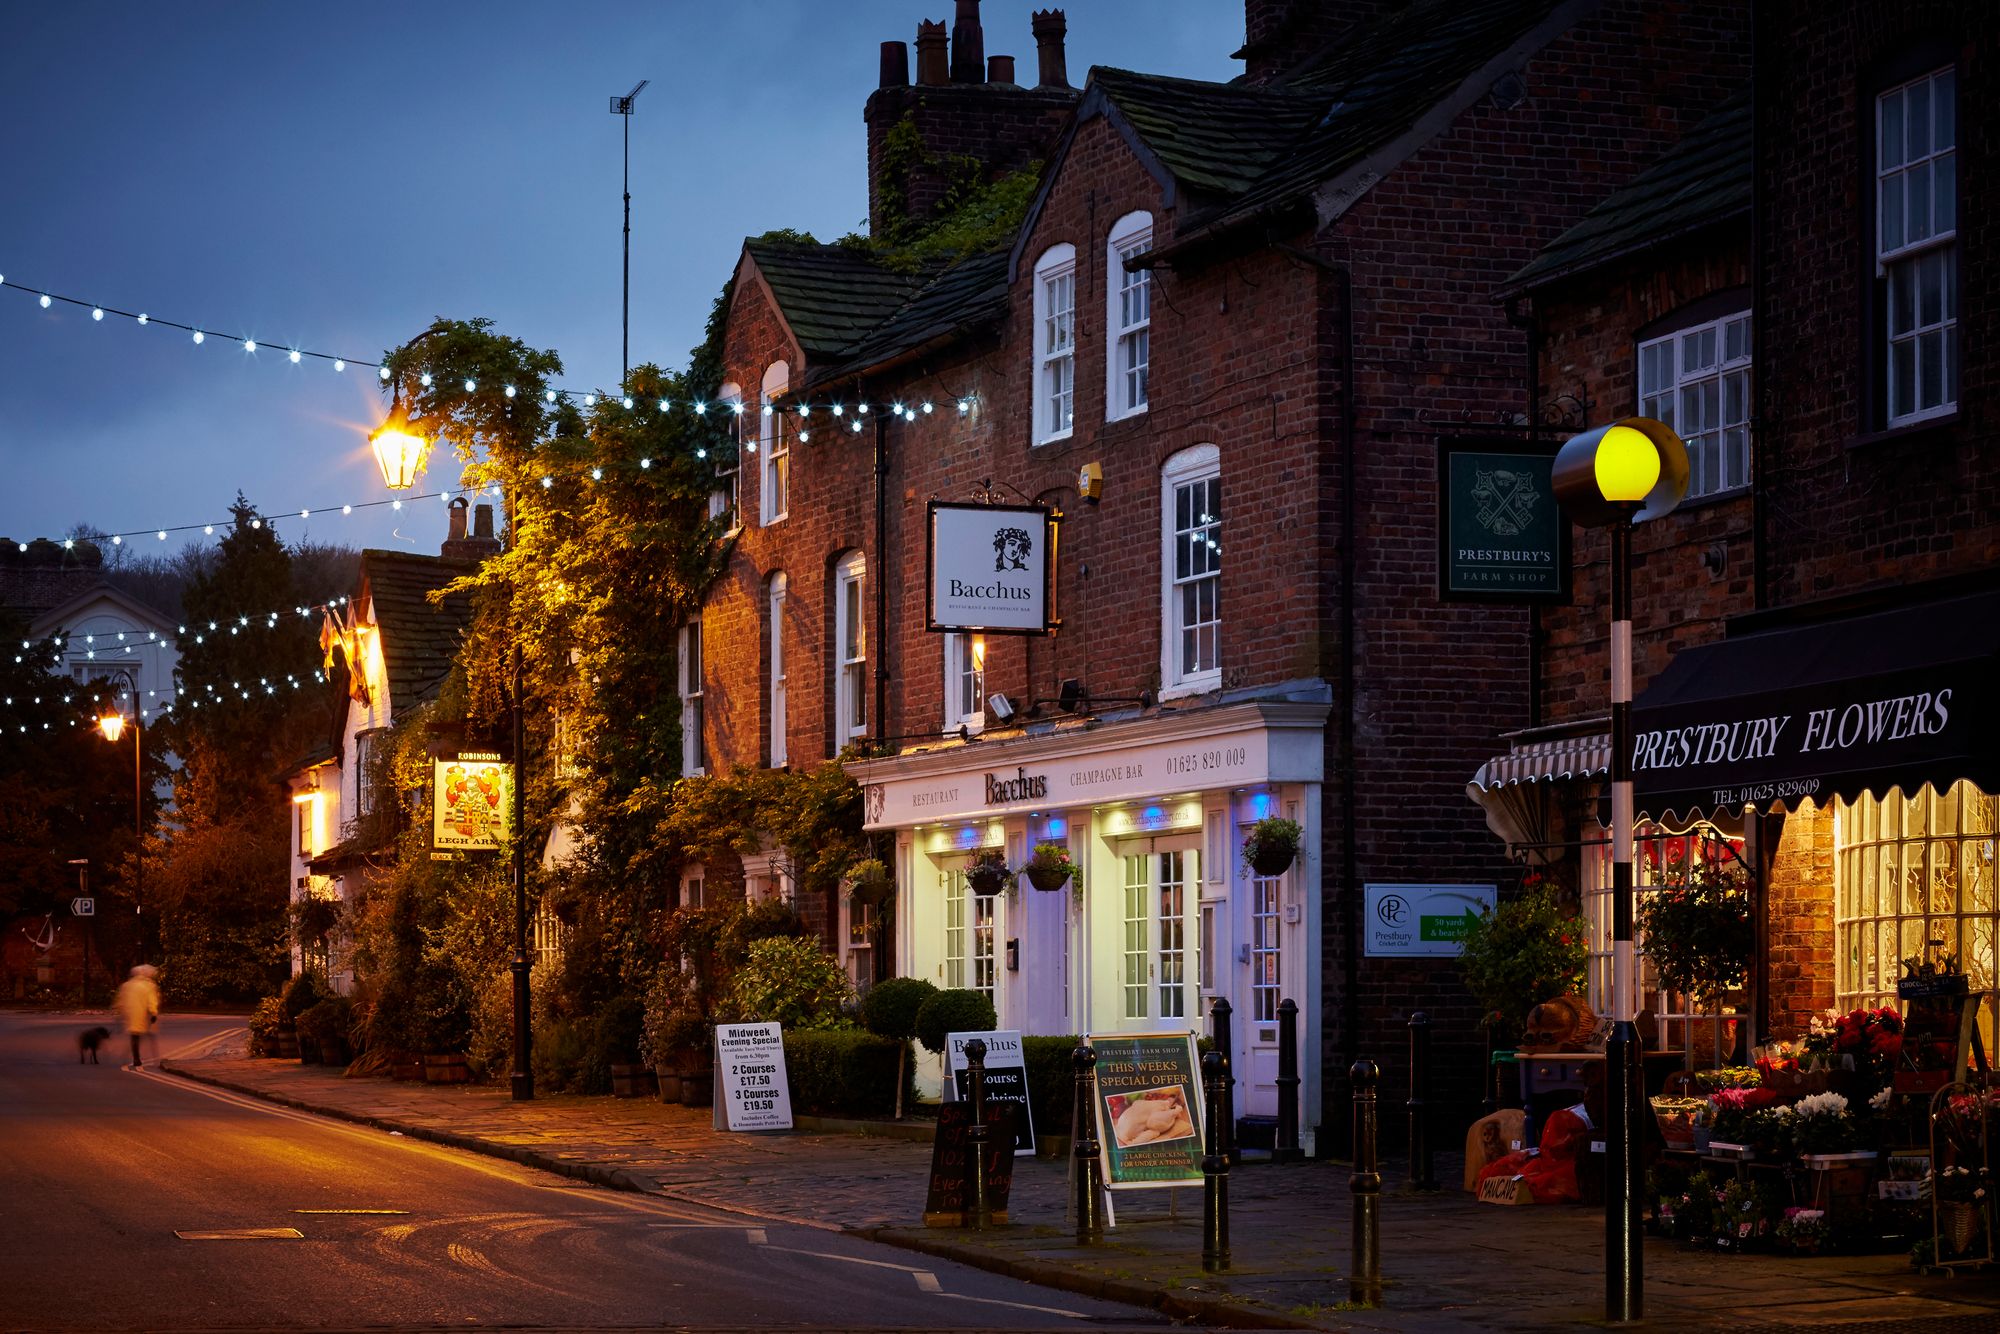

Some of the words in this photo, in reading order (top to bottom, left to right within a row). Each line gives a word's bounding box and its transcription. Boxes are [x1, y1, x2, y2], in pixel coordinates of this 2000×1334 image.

[1458, 549, 1551, 562] PRESTBURY'S
[1463, 572, 1501, 581] FARM
[1509, 573, 1547, 582] SHOP
[950, 579, 1031, 600] Bacchus
[1632, 715, 1791, 771] PRESTBURY
[1799, 688, 1952, 753] FLOWERS
[458, 752, 501, 760] ROBINSONS
[912, 788, 959, 807] RESTAURANT
[984, 766, 1048, 805] Bacchus
[1070, 766, 1123, 787] CHAMPAGNE
[1126, 764, 1144, 779] BAR
[1166, 754, 1198, 775] 01625
[1202, 751, 1221, 770] 820
[1226, 747, 1245, 767] 009
[1713, 789, 1738, 805] TEL:
[1740, 784, 1775, 802] 01625
[1777, 778, 1820, 799] 829609
[437, 837, 469, 845] LEGH
[82, 901, 91, 912] P
[1434, 918, 1444, 927] 50
[1375, 931, 1413, 942] Prestbury
[1430, 929, 1437, 937] &
[729, 1028, 771, 1038] Midweek
[721, 1038, 751, 1047] Evening
[752, 1036, 780, 1046] Special
[953, 1037, 1018, 1054] Bchus
[732, 1065, 738, 1075] 2
[740, 1064, 776, 1074] Courses
[1107, 1062, 1135, 1073] THIS
[1136, 1060, 1178, 1072] WEEKS
[740, 1075, 770, 1086] £17.50
[983, 1072, 1018, 1084] ourse
[1101, 1075, 1149, 1087] SPECIAL
[1151, 1074, 1189, 1085] OFFER
[735, 1090, 741, 1100] 3
[743, 1089, 780, 1099] Courses
[744, 1100, 774, 1111] £19.50
